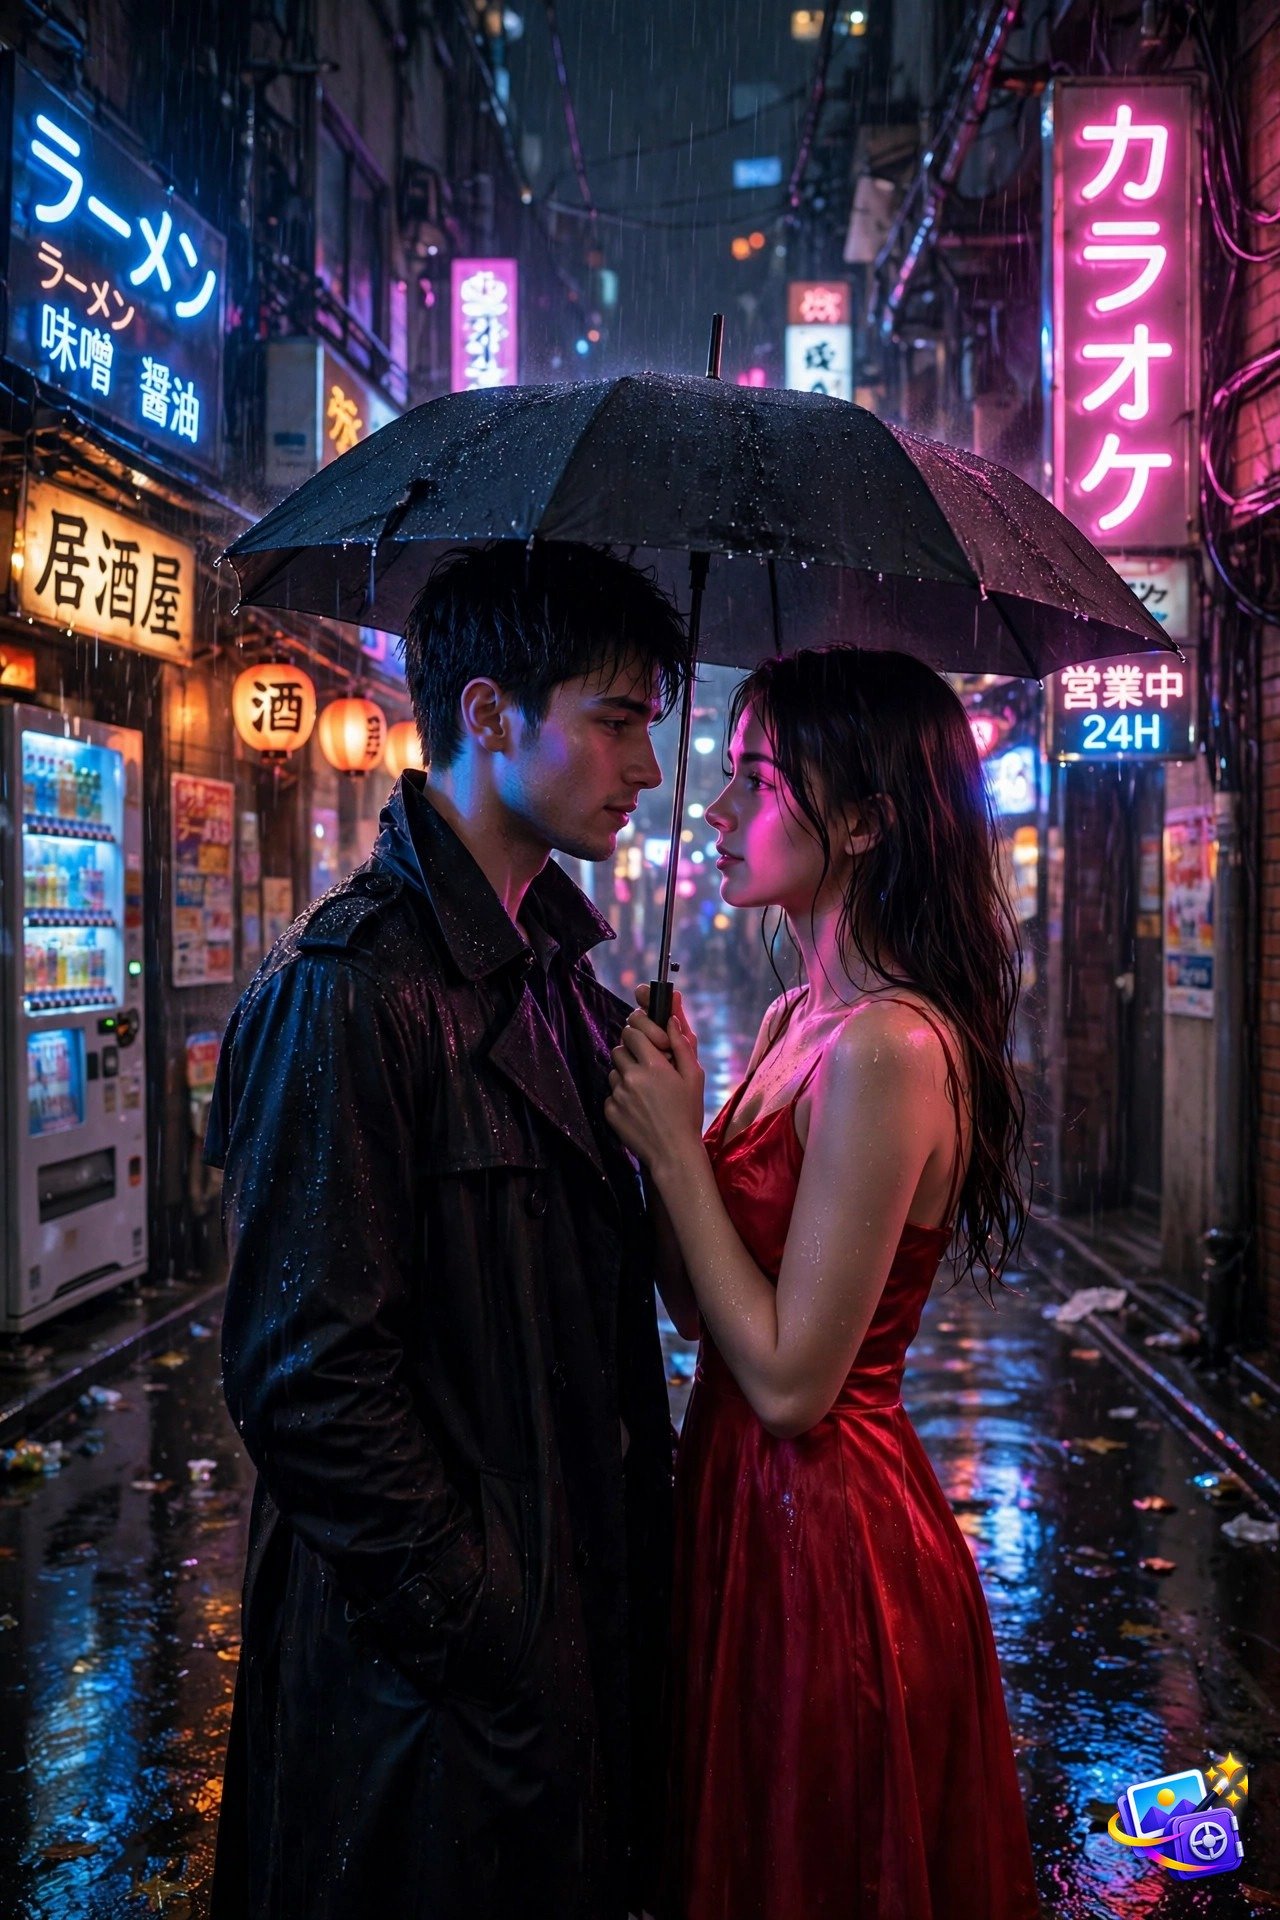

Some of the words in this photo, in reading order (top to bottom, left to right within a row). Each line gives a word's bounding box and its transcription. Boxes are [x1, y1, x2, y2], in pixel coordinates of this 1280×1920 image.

[31, 114, 216, 318] ラーメン
[38, 241, 135, 331] ラーメン
[1081, 104, 1173, 531] カラオケ
[41, 303, 114, 397] 味噌
[140, 356, 200, 444] 醤油
[34, 508, 181, 642] 居酒屋
[251, 681, 303, 733] 酒
[1061, 664, 1184, 710] 営業中
[1082, 713, 1160, 750] 24H
